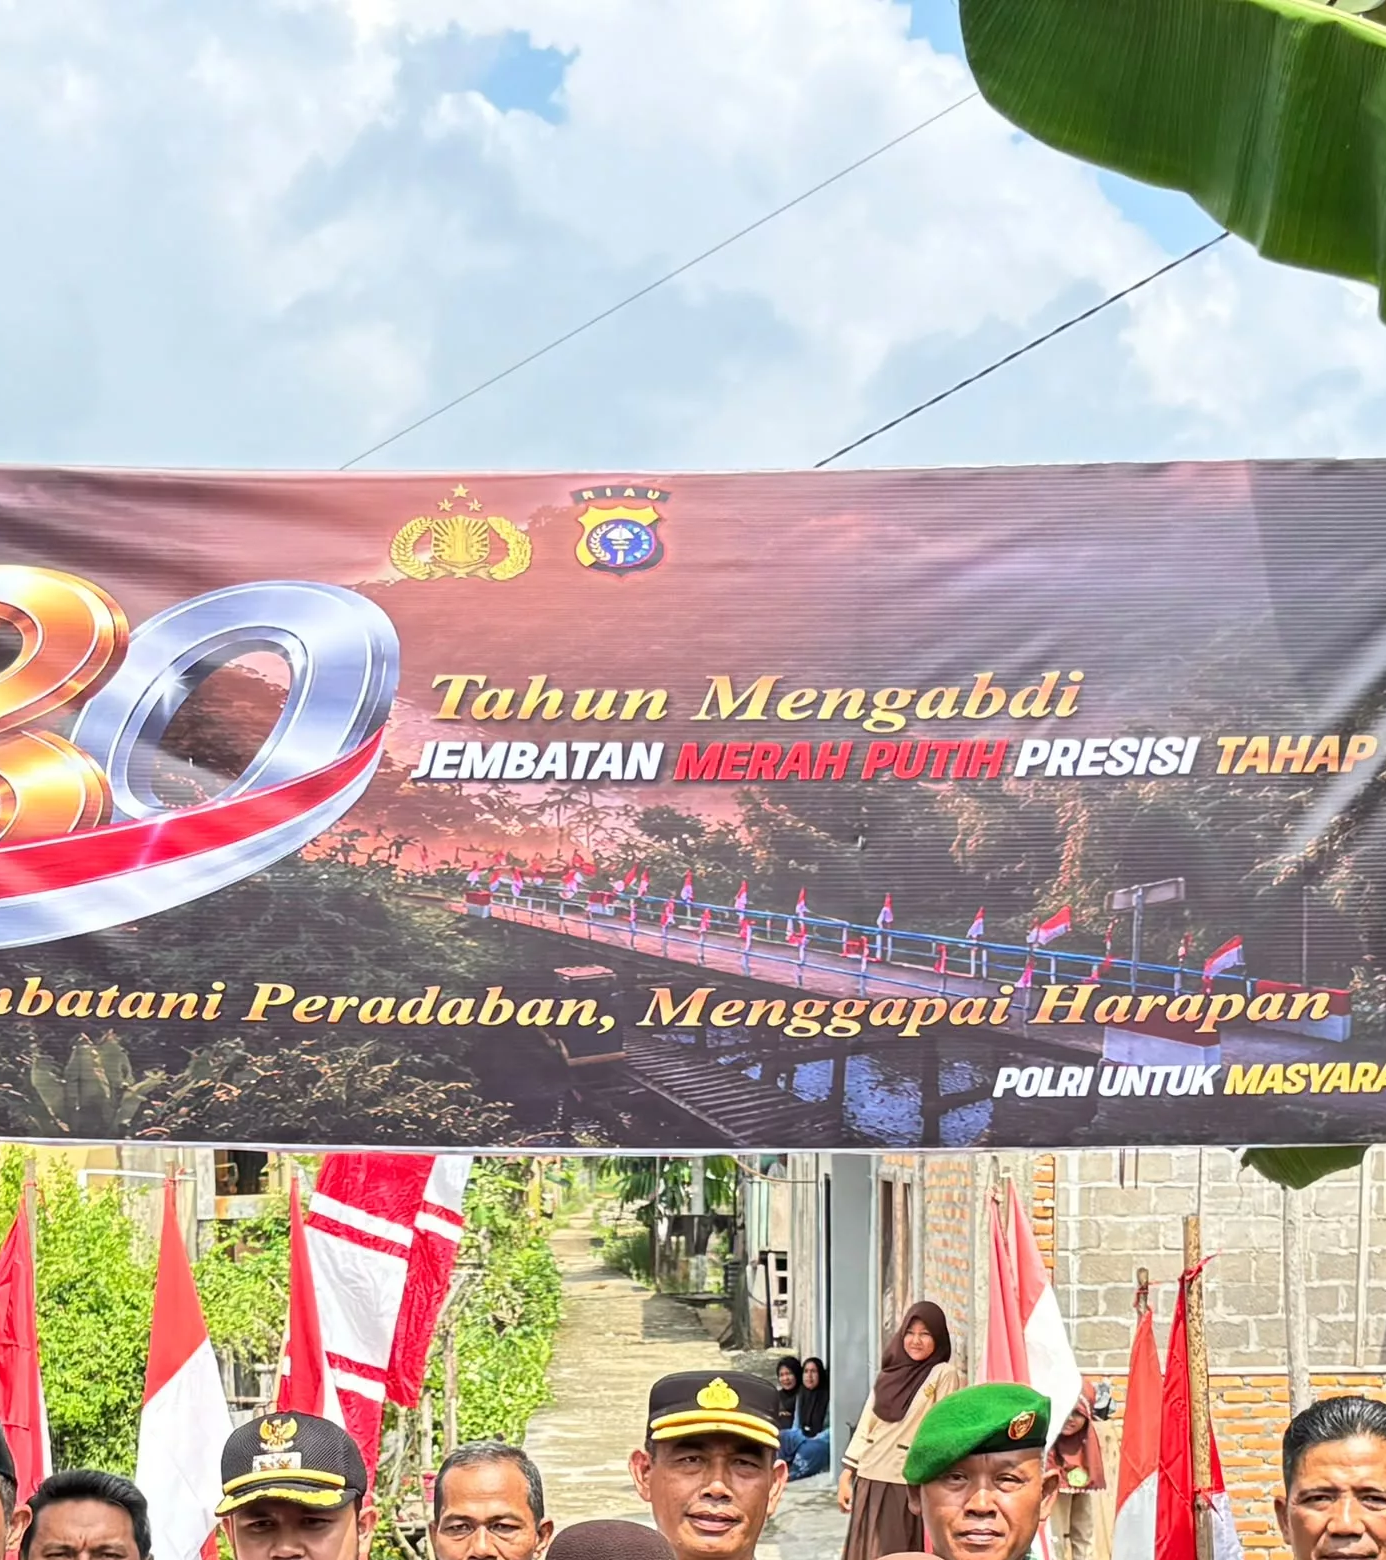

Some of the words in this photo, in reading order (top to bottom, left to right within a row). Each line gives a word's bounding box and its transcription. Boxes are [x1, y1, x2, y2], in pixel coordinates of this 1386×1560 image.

[580, 486, 661, 501] RIAU
[429, 673, 669, 722] Tahun
[689, 670, 1085, 734] Mengabdi
[410, 741, 666, 782] JEMBATAN
[673, 740, 853, 781] MERAH
[860, 739, 1009, 781] PUTIH
[1013, 736, 1203, 777] PRESISI
[1215, 733, 1379, 774] TAHAP
[240, 982, 617, 1035] Peradaban,
[635, 984, 1016, 1038] Menggapai
[1025, 983, 1331, 1034] Harapan
[991, 1066, 1091, 1099] POLRI
[1096, 1066, 1221, 1097] UNTUK
